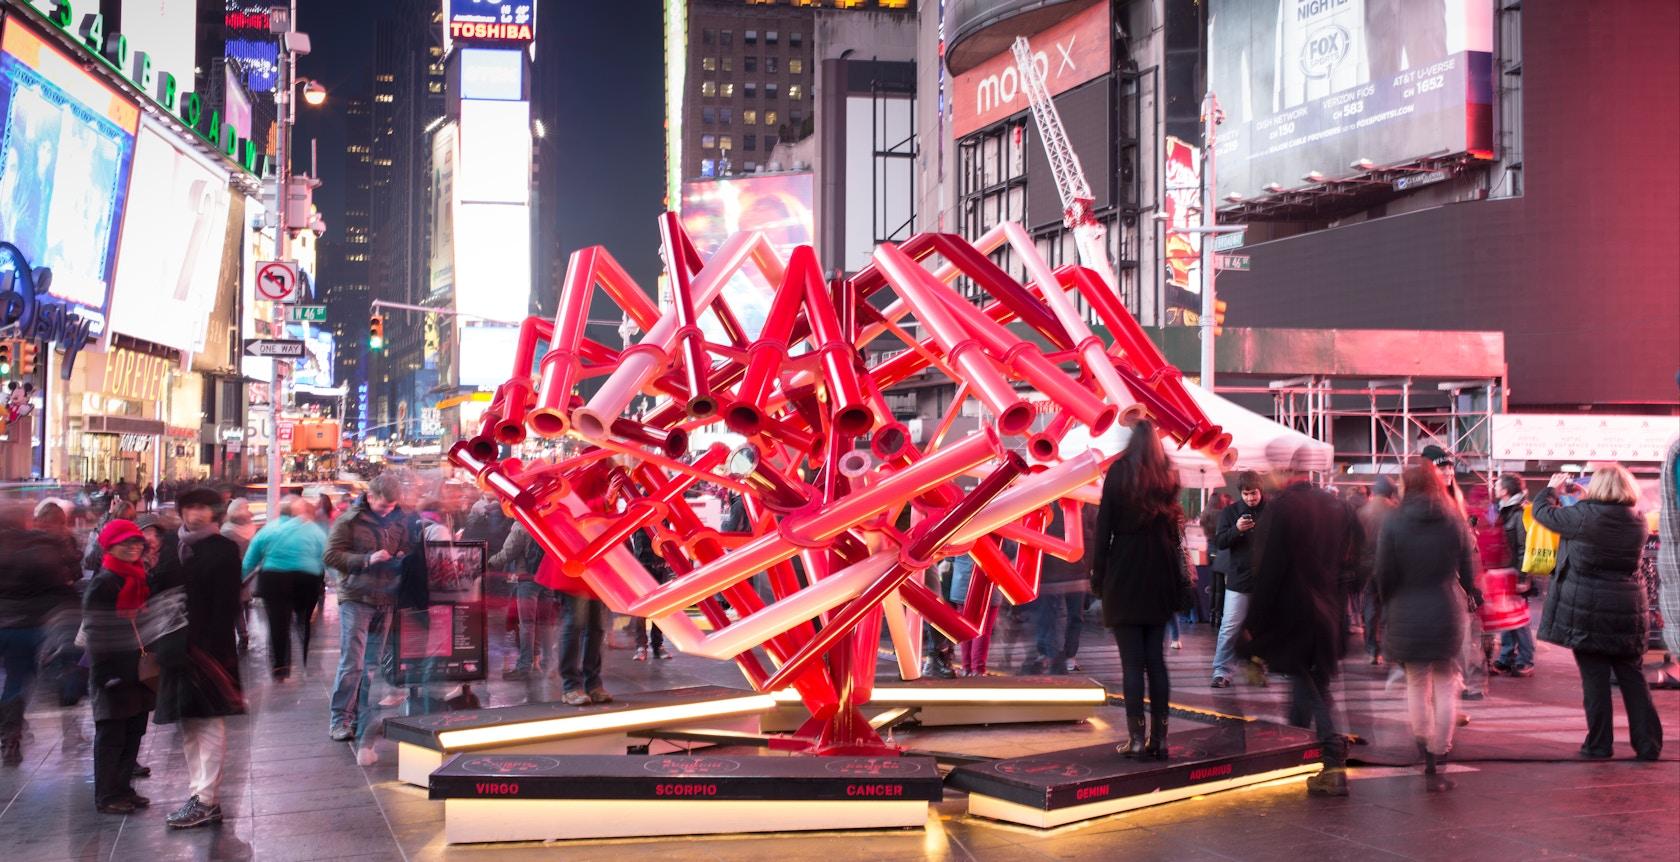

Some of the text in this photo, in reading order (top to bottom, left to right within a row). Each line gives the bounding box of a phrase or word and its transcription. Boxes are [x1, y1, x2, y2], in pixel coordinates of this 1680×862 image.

[450, 22, 532, 40] TOSHIBA
[1309, 31, 1339, 60] FOX
[1393, 58, 1455, 88] AT&T U-VERSE
[1416, 75, 1444, 94] 1652
[133, 50, 272, 179] BROADWA
[1273, 107, 1308, 126] NETWORK
[1343, 101, 1364, 117] 583
[1278, 122, 1295, 137] 150
[1231, 257, 1241, 269] 46
[295, 307, 302, 320] W
[303, 307, 315, 320] 46
[260, 344, 299, 353] ONE WAY
[103, 344, 169, 401] FOREVER
[1189, 764, 1232, 781] AQUARIUS
[475, 783, 520, 795] VIRGO
[655, 784, 717, 796] SCORPIO
[846, 784, 903, 796] CANCER
[1076, 785, 1110, 800] GEMINI
